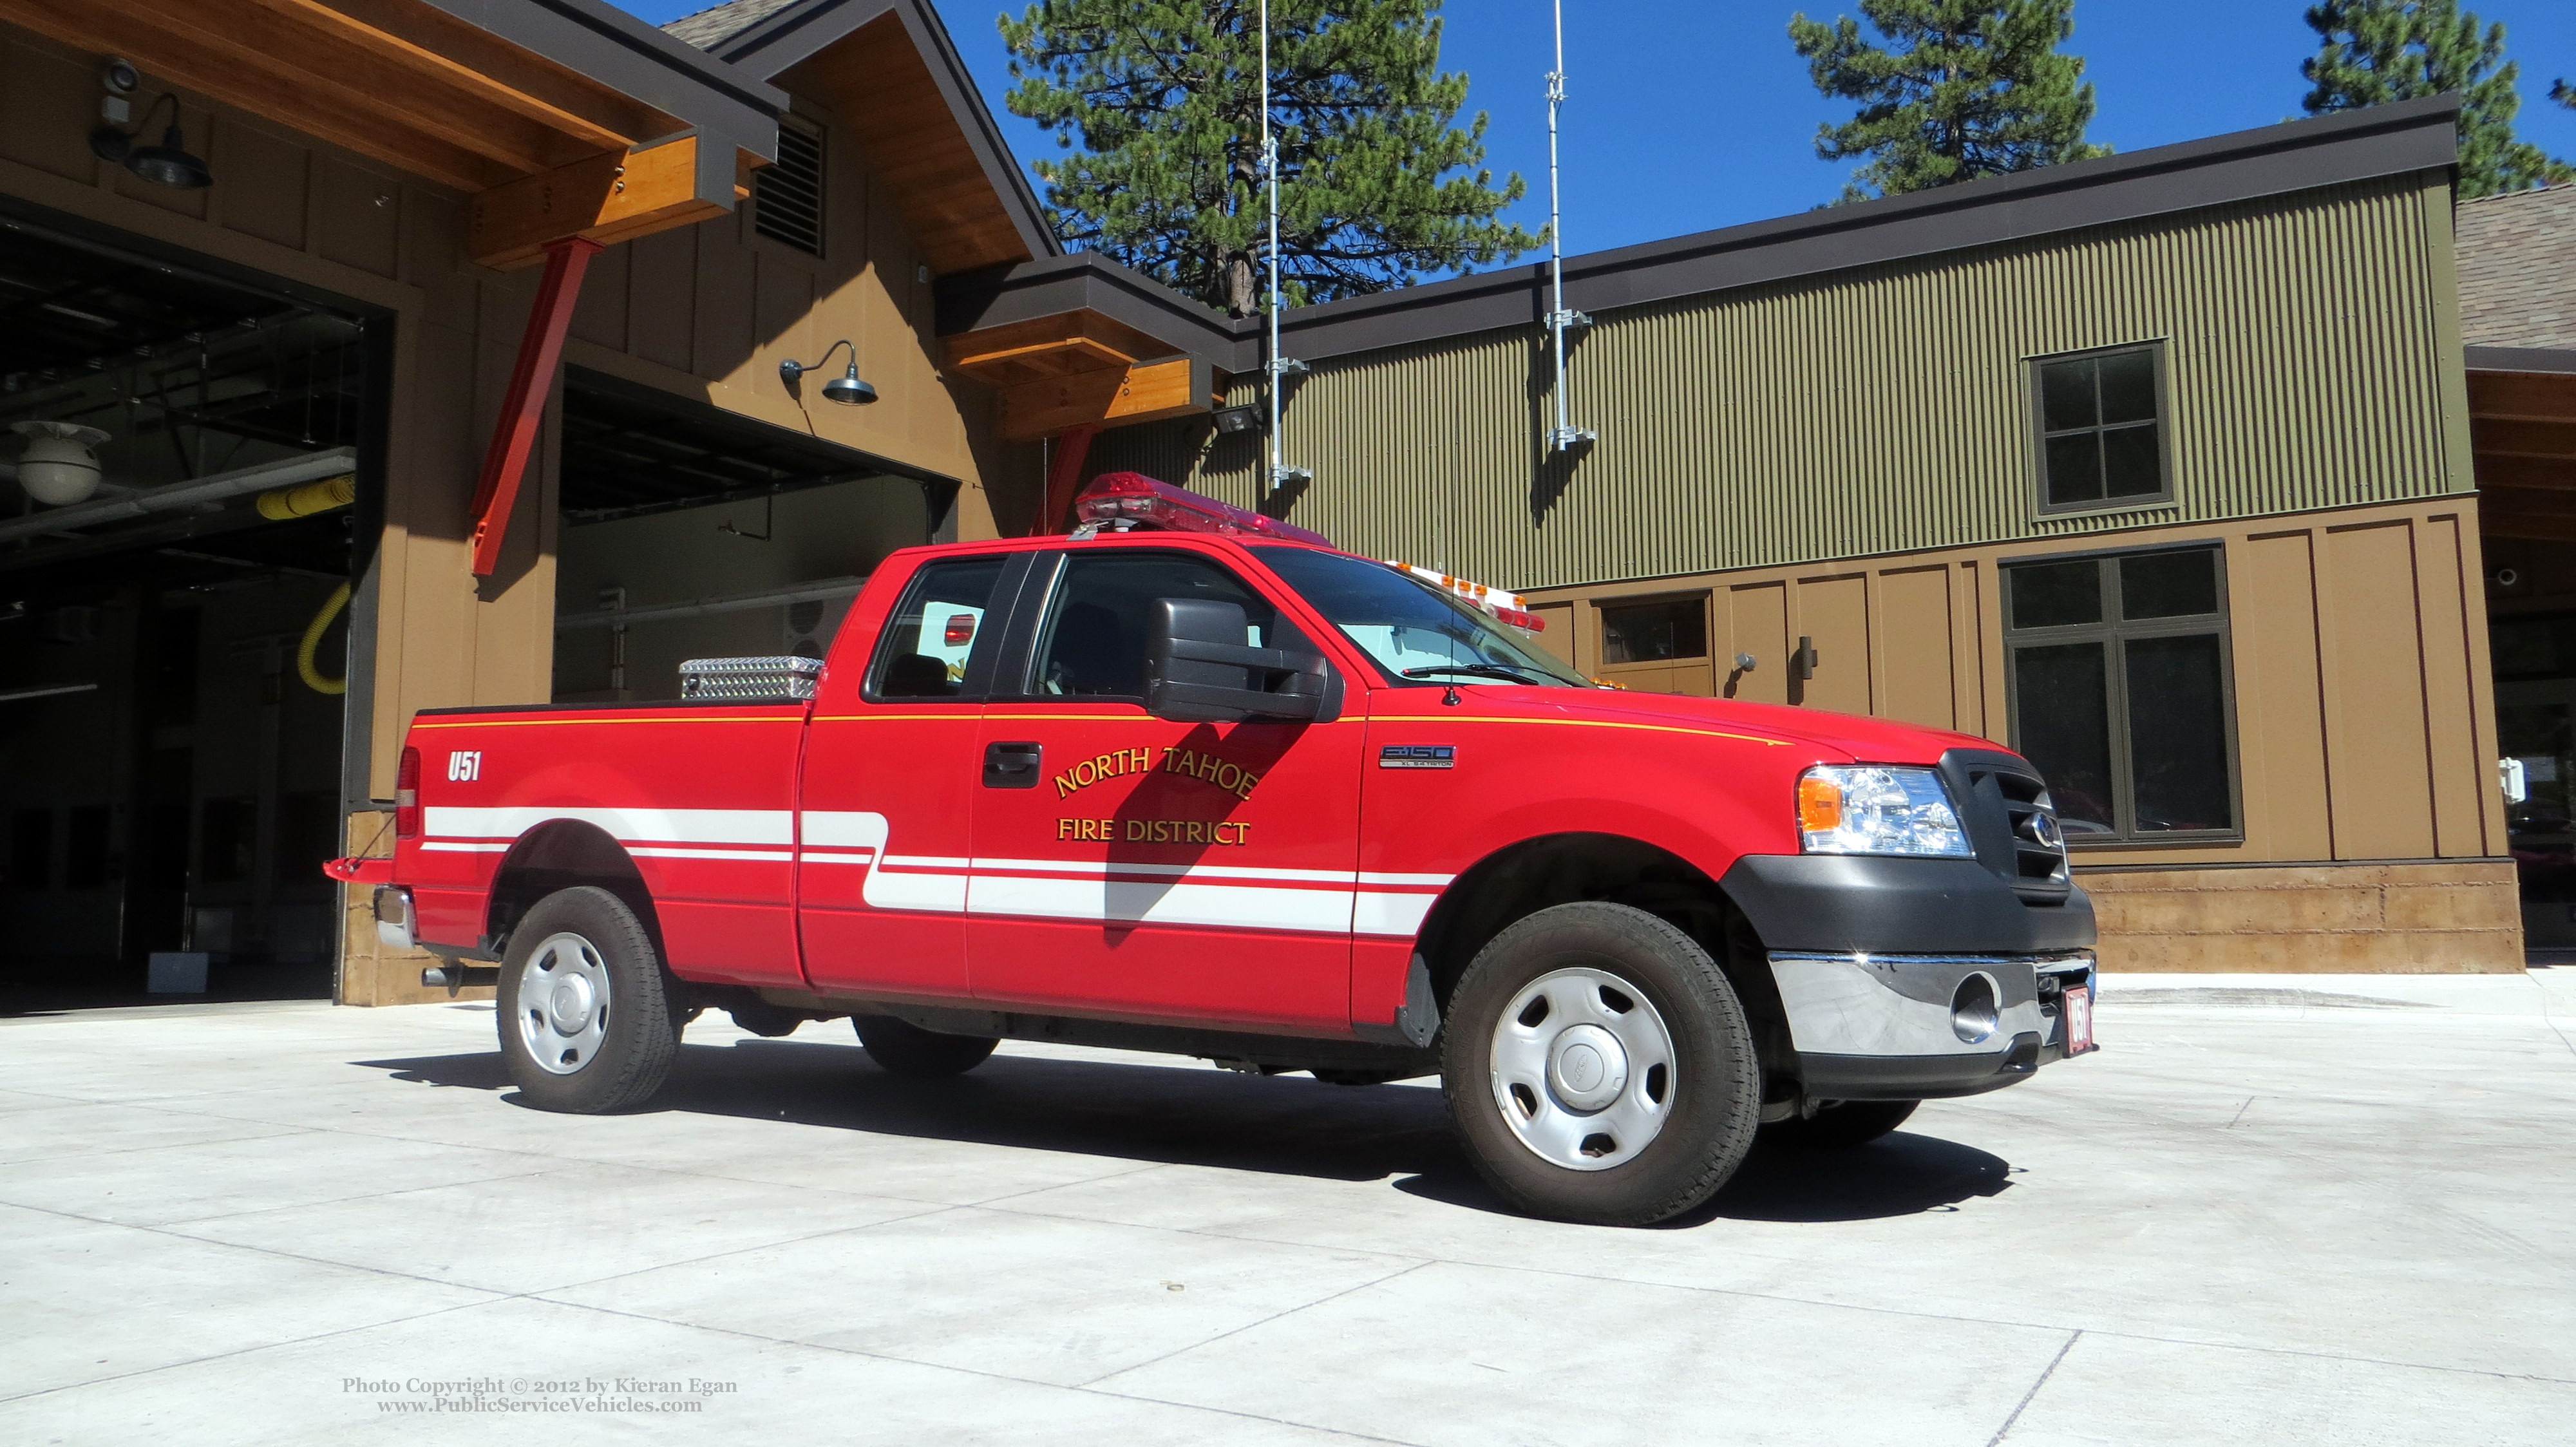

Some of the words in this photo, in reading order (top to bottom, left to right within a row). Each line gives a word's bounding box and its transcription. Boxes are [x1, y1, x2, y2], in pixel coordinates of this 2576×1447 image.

[448, 751, 482, 781] U51
[1054, 746, 1151, 800] NORTH
[1162, 747, 1259, 800] TAHOE
[1057, 818, 1115, 840] FIRE
[1126, 820, 1251, 845] DISTRICT
